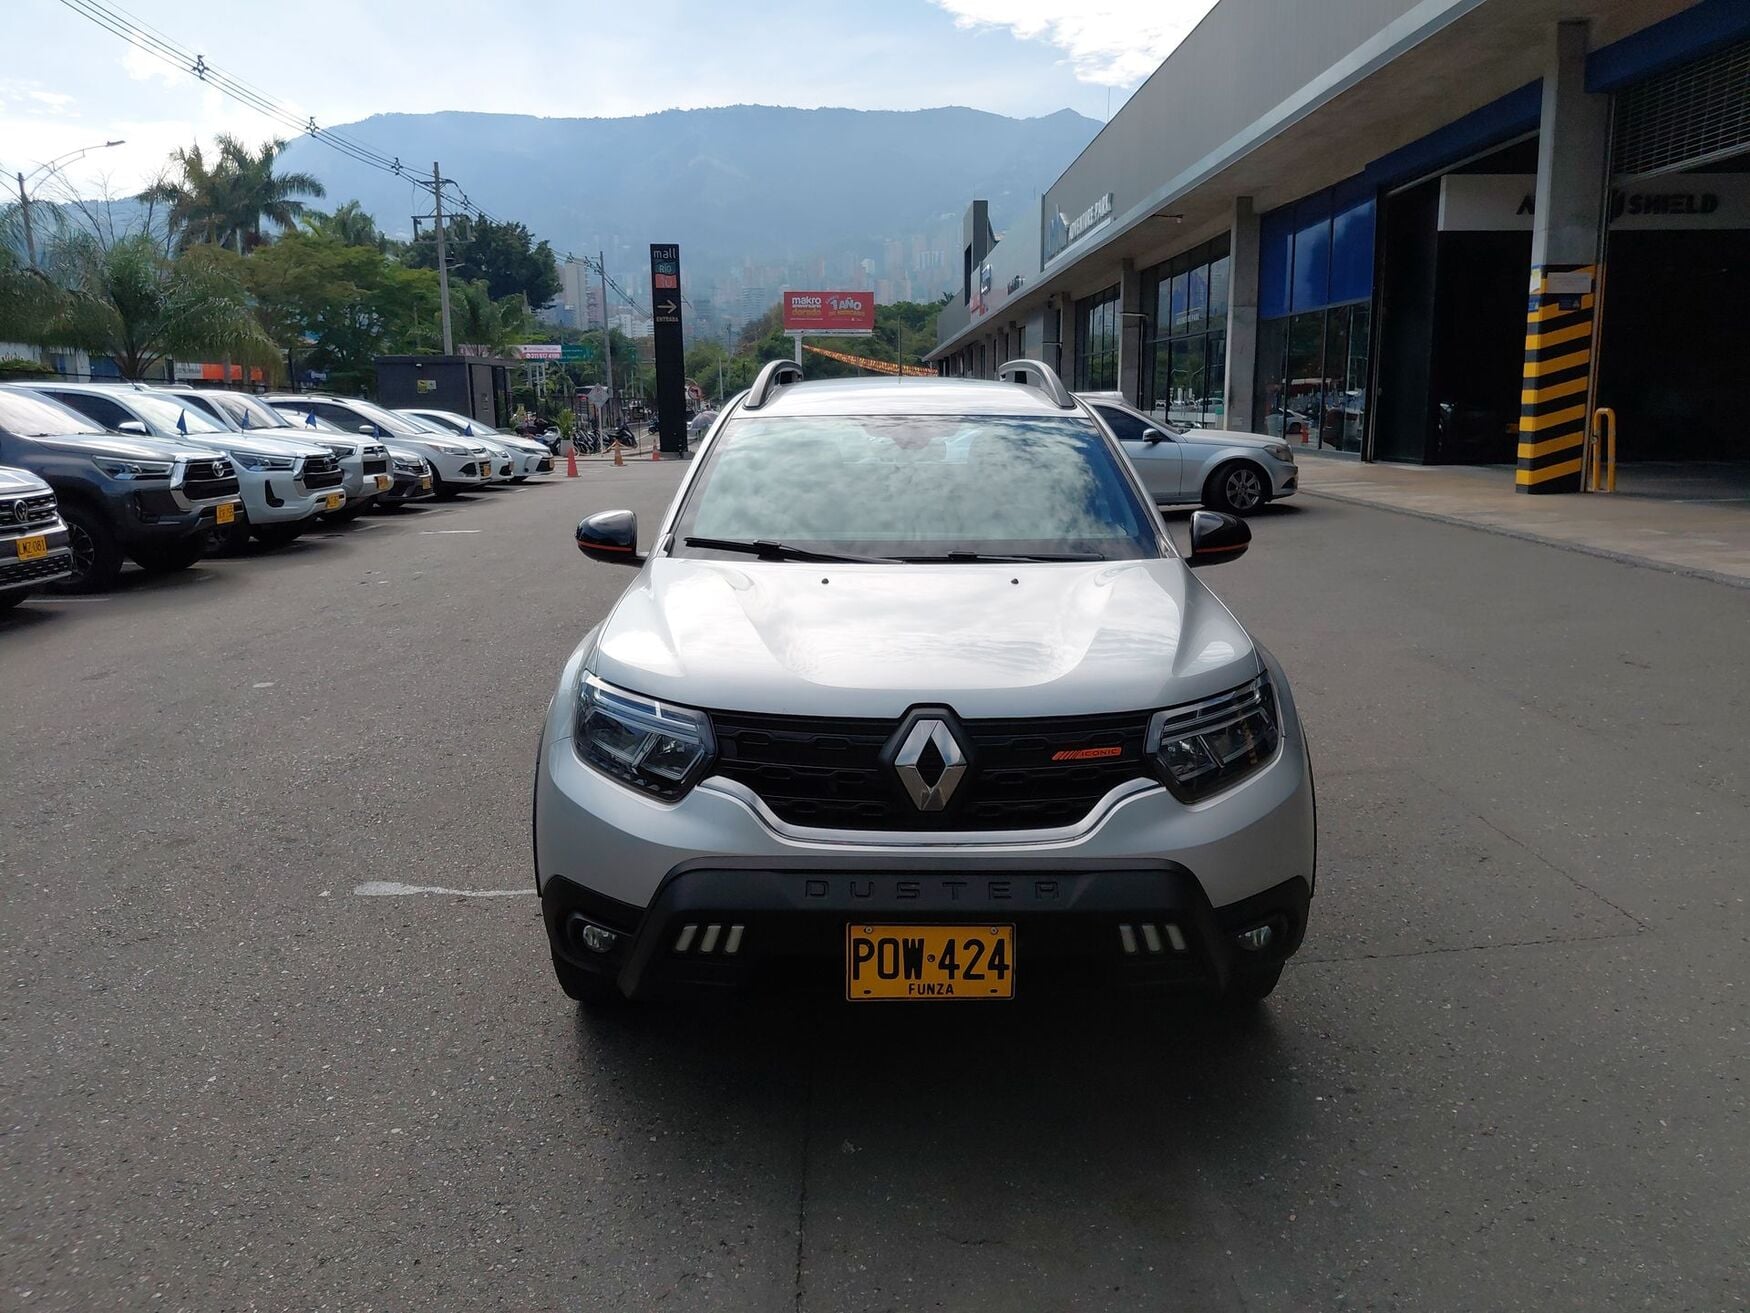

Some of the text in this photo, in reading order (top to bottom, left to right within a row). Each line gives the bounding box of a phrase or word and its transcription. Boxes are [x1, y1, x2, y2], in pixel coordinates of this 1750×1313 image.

[1628, 193, 1719, 215] SHIELD
[653, 248, 677, 259] mall
[792, 296, 822, 305] makro
[839, 297, 862, 311] AÑO
[1081, 748, 1120, 758] ICONIC
[805, 880, 1060, 899] DUSTER
[853, 938, 1010, 980] POW 424
[908, 983, 954, 995] FUNZA
